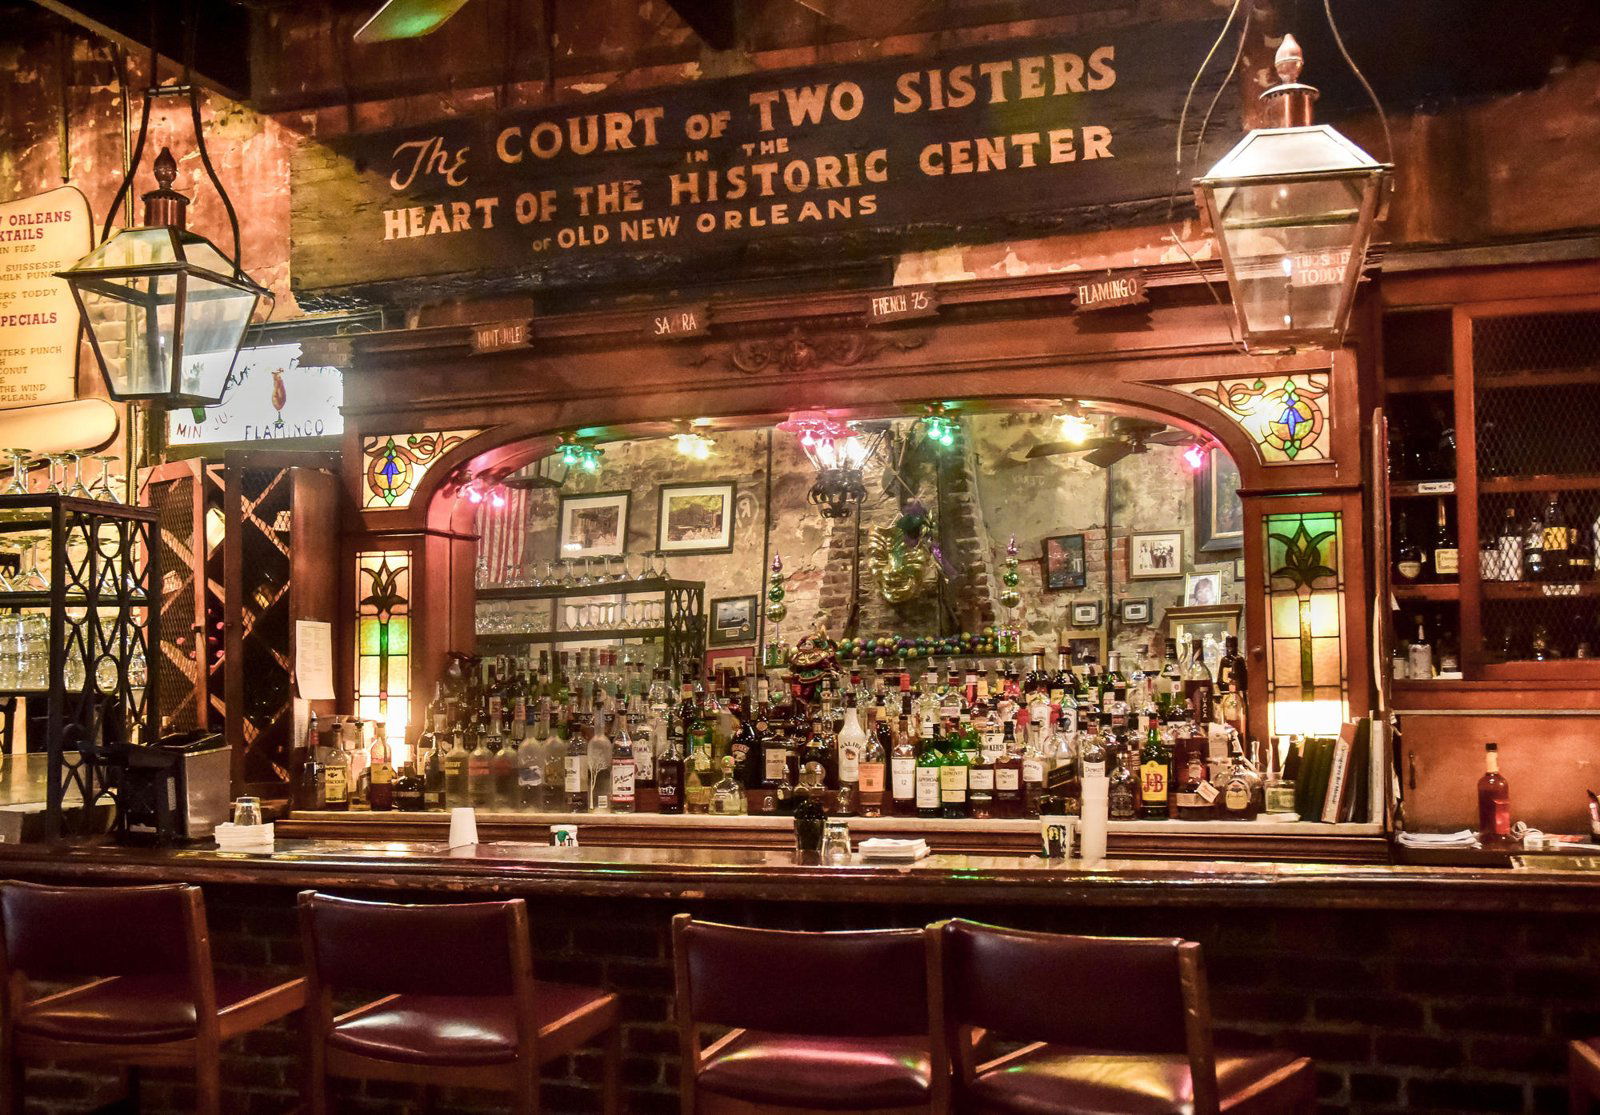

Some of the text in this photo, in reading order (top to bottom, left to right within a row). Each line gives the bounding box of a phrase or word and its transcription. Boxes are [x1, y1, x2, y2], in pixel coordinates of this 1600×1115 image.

[390, 46, 1117, 190] The COURT OF TWO SISTERS
[686, 138, 790, 163] IN THE
[383, 125, 1115, 240] HEART OF THE HISTORIC CENTER
[9, 210, 72, 227] ORLEANS
[557, 224, 610, 249] OLD
[620, 216, 681, 242] NEW
[696, 195, 877, 233] ORLEANS
[15, 244, 36, 253] FIZZ
[6, 261, 61, 272] SUISSESSE
[1298, 266, 1346, 284] TODDY
[22, 288, 58, 298] TODDY
[1078, 279, 1138, 304] FLAMINGO
[872, 291, 931, 316] FRENCH 75
[478, 330, 499, 349] MINT
[30, 345, 62, 355] PUNCH
[21, 383, 46, 392] WIND
